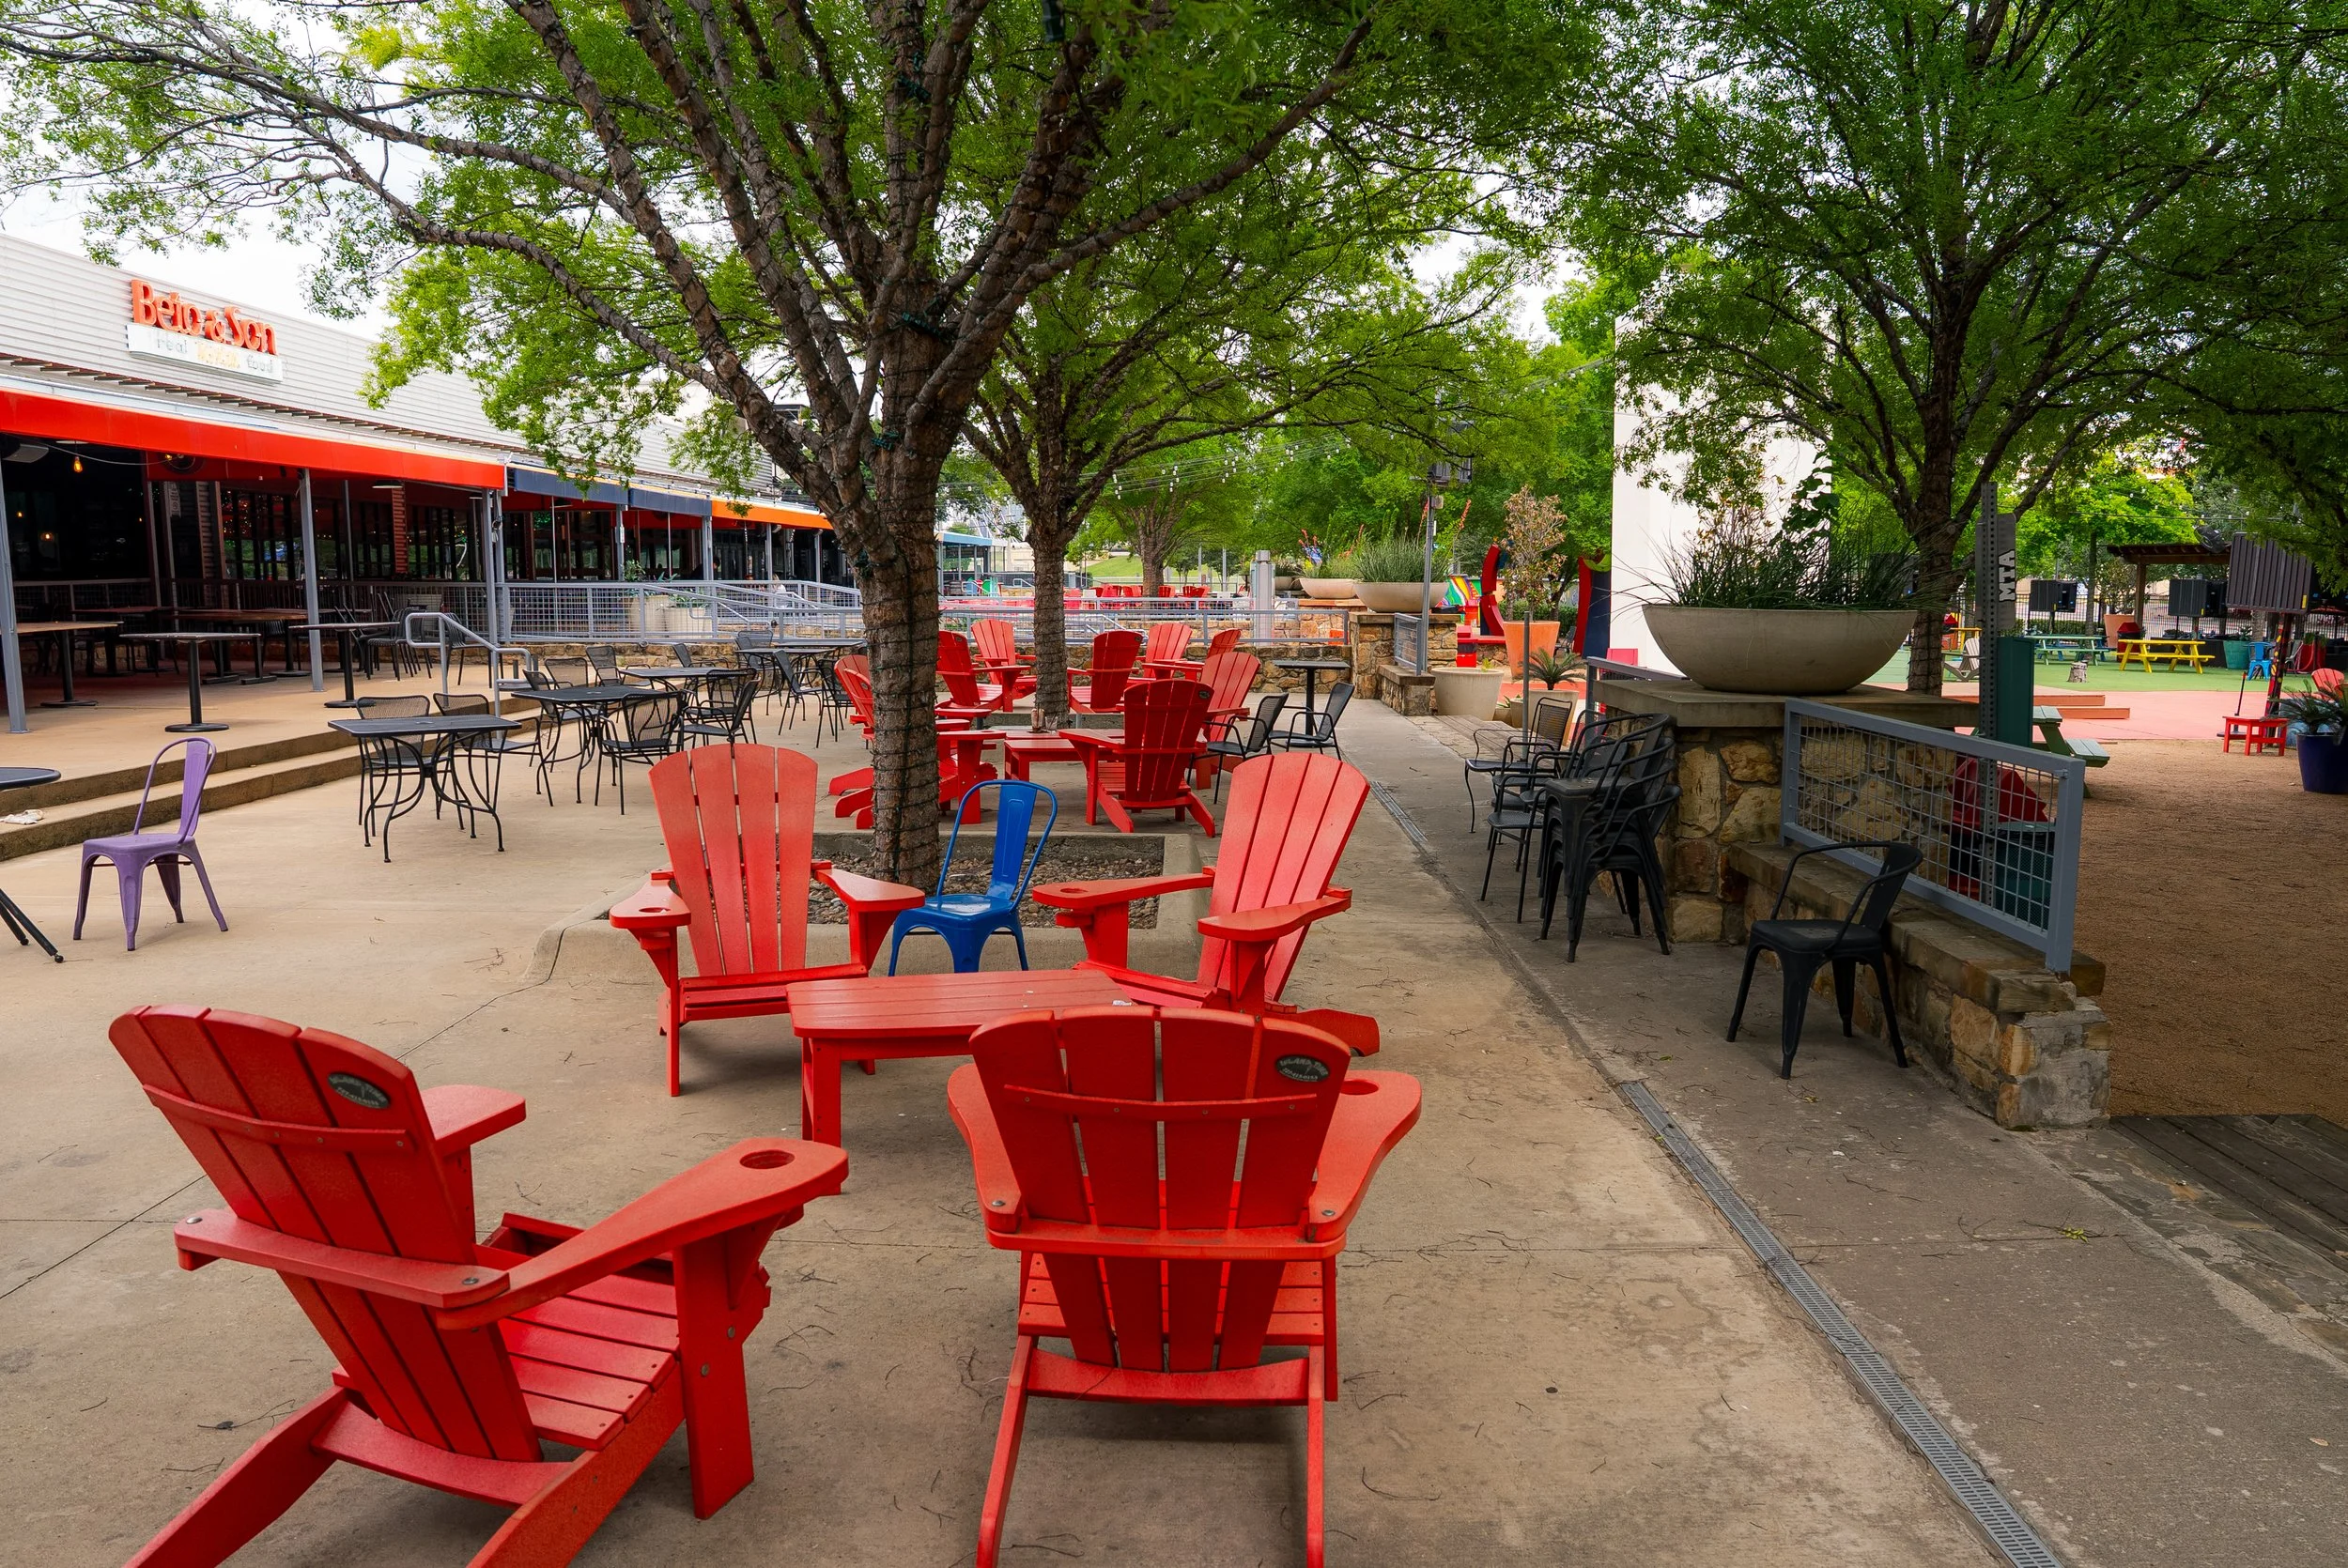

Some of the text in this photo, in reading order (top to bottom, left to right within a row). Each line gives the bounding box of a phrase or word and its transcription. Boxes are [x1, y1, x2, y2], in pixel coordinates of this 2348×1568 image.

[131, 278, 203, 336] Beto
[204, 309, 225, 344] &
[224, 305, 278, 356] Son
[1998, 549, 2016, 602] MTA
